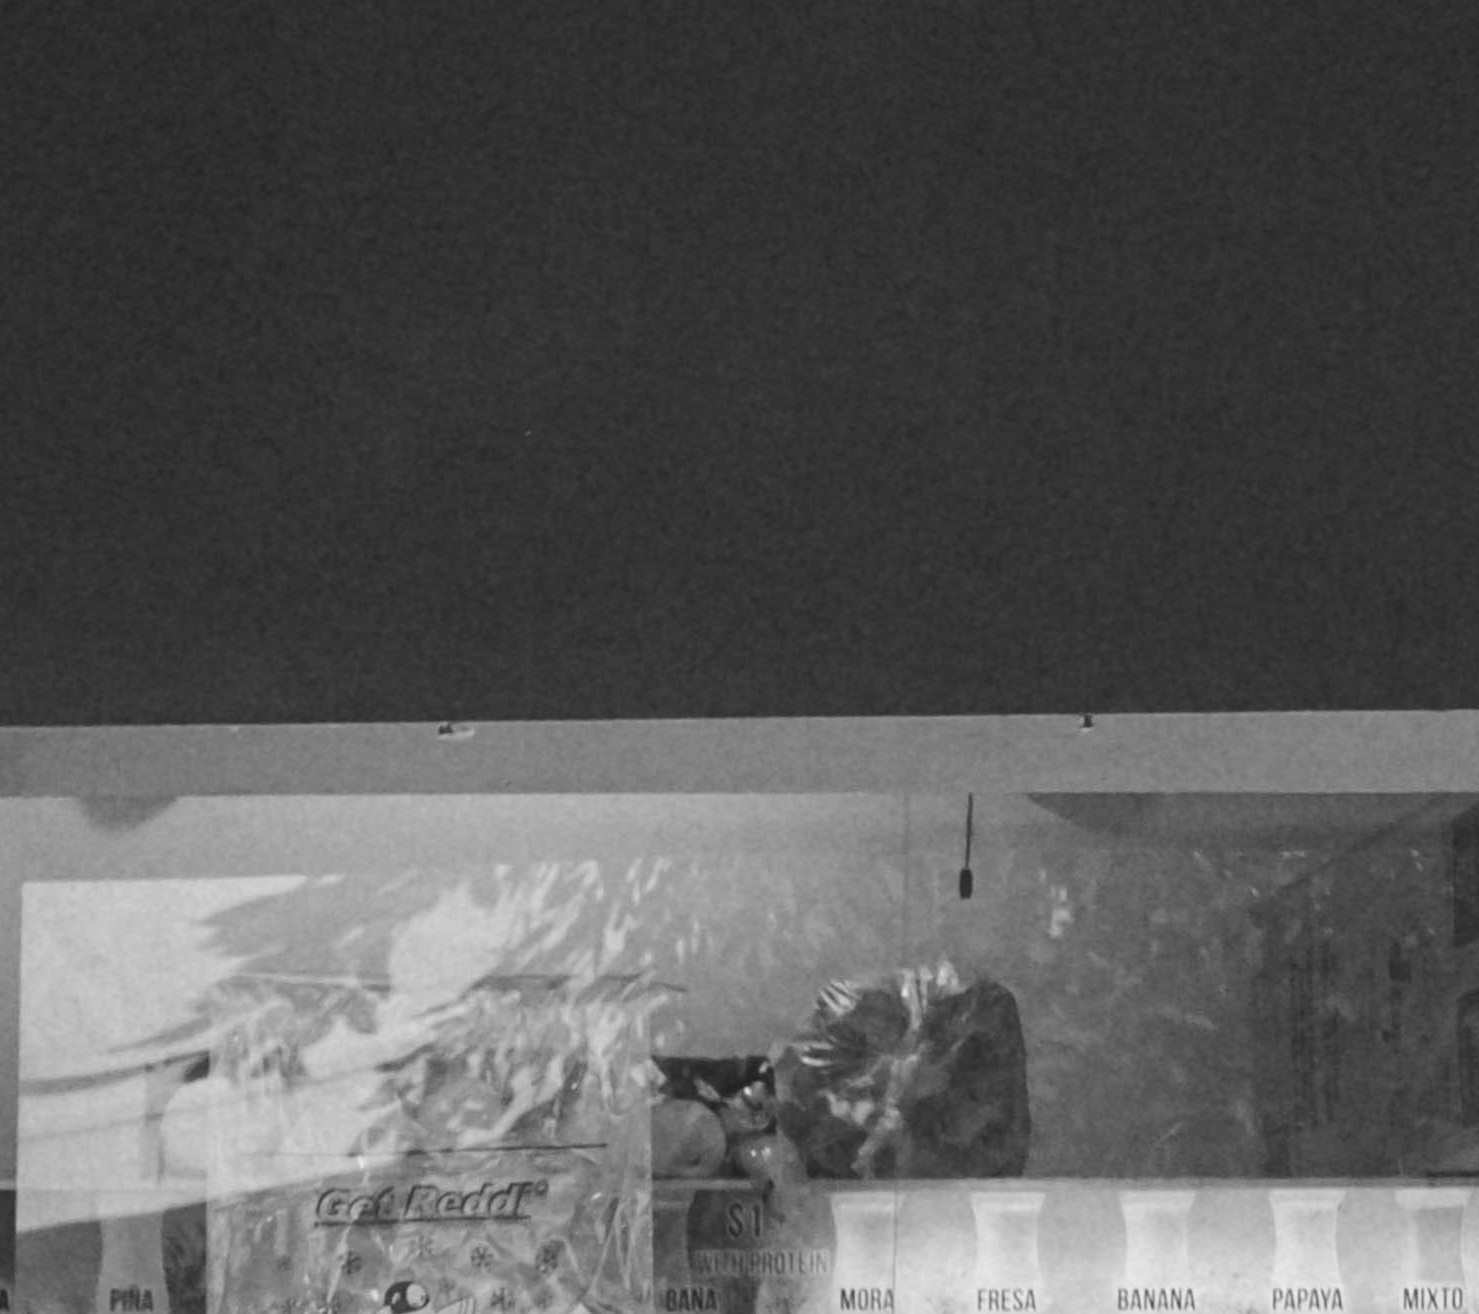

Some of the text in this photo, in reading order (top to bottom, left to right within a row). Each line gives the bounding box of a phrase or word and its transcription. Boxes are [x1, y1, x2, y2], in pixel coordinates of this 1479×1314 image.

[316, 1186, 393, 1220] Get
[749, 1252, 829, 1274] PROTEIN
[840, 1287, 894, 1311] MORA
[977, 1288, 1037, 1312] FRESA
[1117, 1288, 1195, 1312] BANANA
[1272, 1287, 1343, 1311] PAPAYA
[1403, 1287, 1464, 1311] MIXTO
